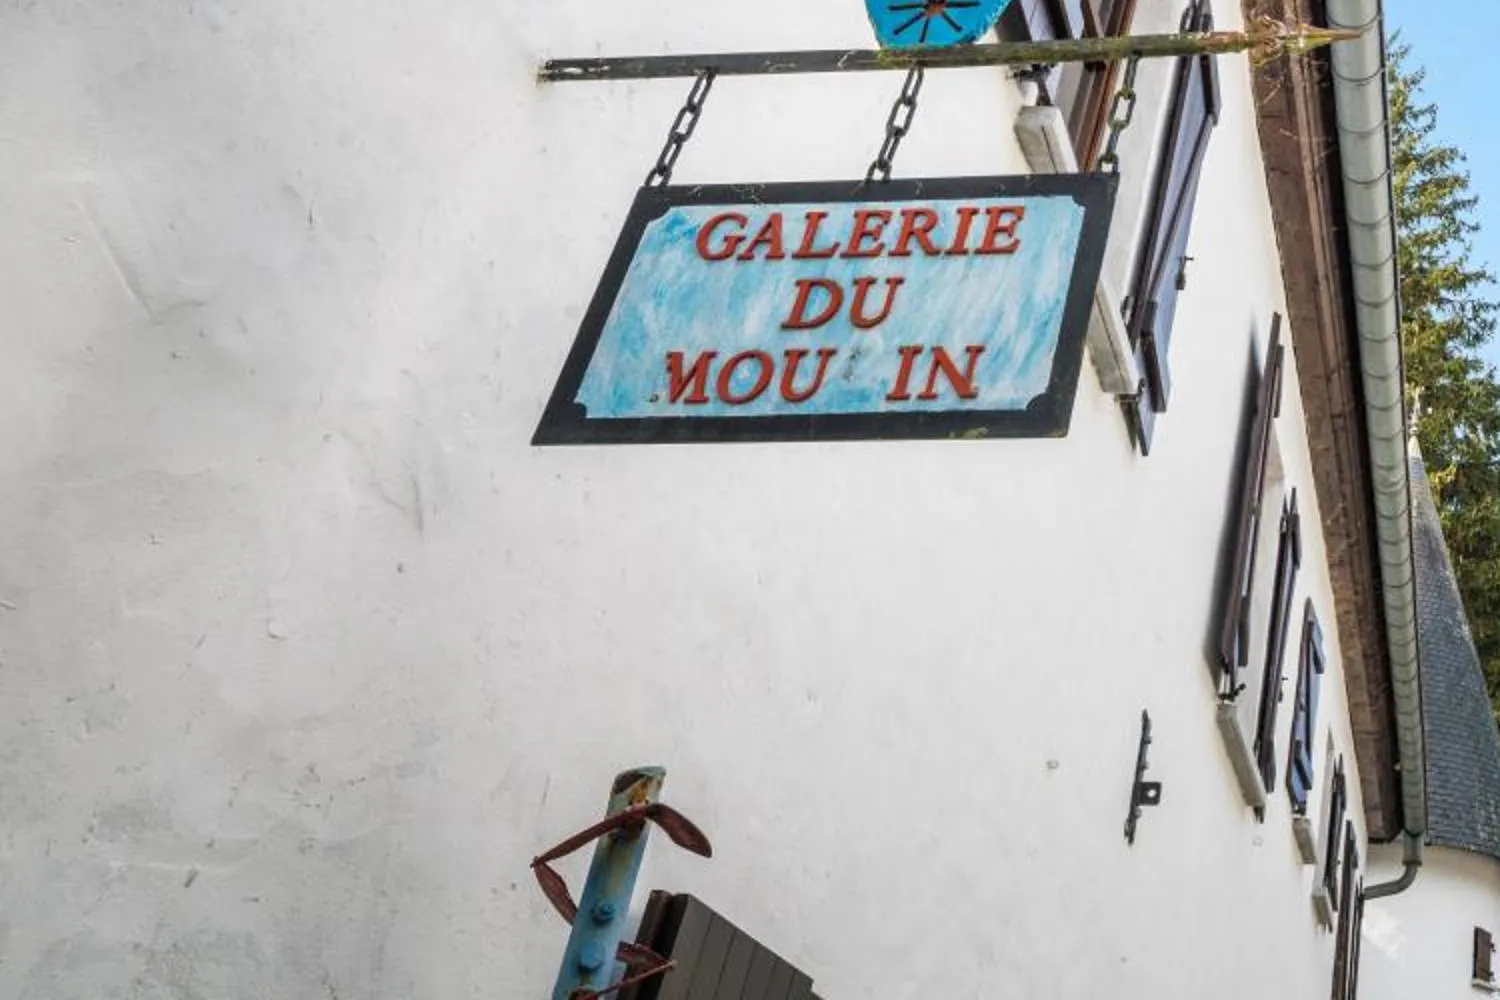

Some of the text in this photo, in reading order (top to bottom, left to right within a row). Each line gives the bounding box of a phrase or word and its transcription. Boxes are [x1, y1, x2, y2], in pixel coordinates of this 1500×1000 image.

[695, 205, 1025, 261] GALERIE
[780, 276, 904, 331] DU
[664, 345, 986, 405] MOUIN
